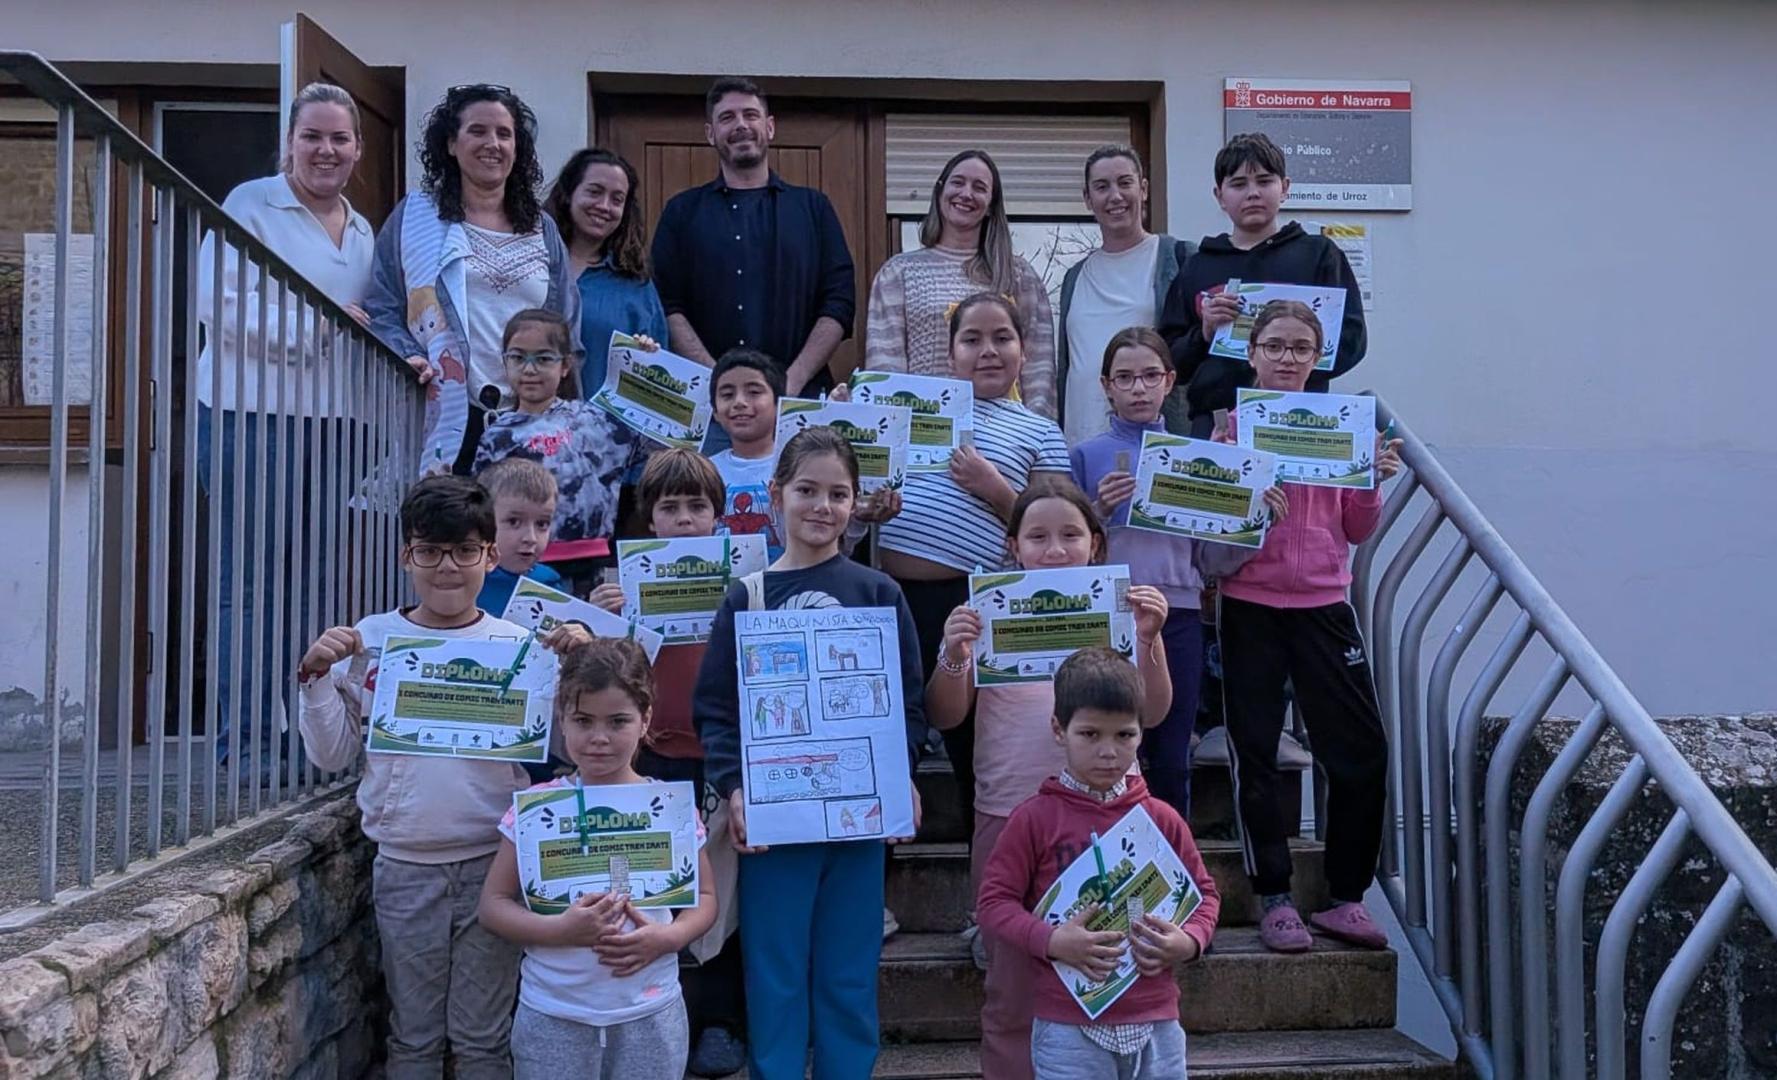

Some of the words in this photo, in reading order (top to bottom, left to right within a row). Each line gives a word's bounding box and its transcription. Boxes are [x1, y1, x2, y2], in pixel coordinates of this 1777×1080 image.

[1256, 93, 1315, 106] Gobierno
[1321, 95, 1337, 106] de
[1343, 95, 1391, 107] Navarra
[1296, 144, 1332, 155] Público
[1326, 192, 1338, 200] de
[1342, 192, 1368, 201] Urroz
[631, 362, 689, 395] DIPLOMA
[1269, 412, 1340, 430] DIPLOMA
[1170, 459, 1241, 484] DIPLOMA
[656, 560, 722, 578] DIPLOM
[1009, 594, 1092, 615] DIPLOMA
[744, 617, 762, 630] LA
[599, 844, 625, 852] COMIC
